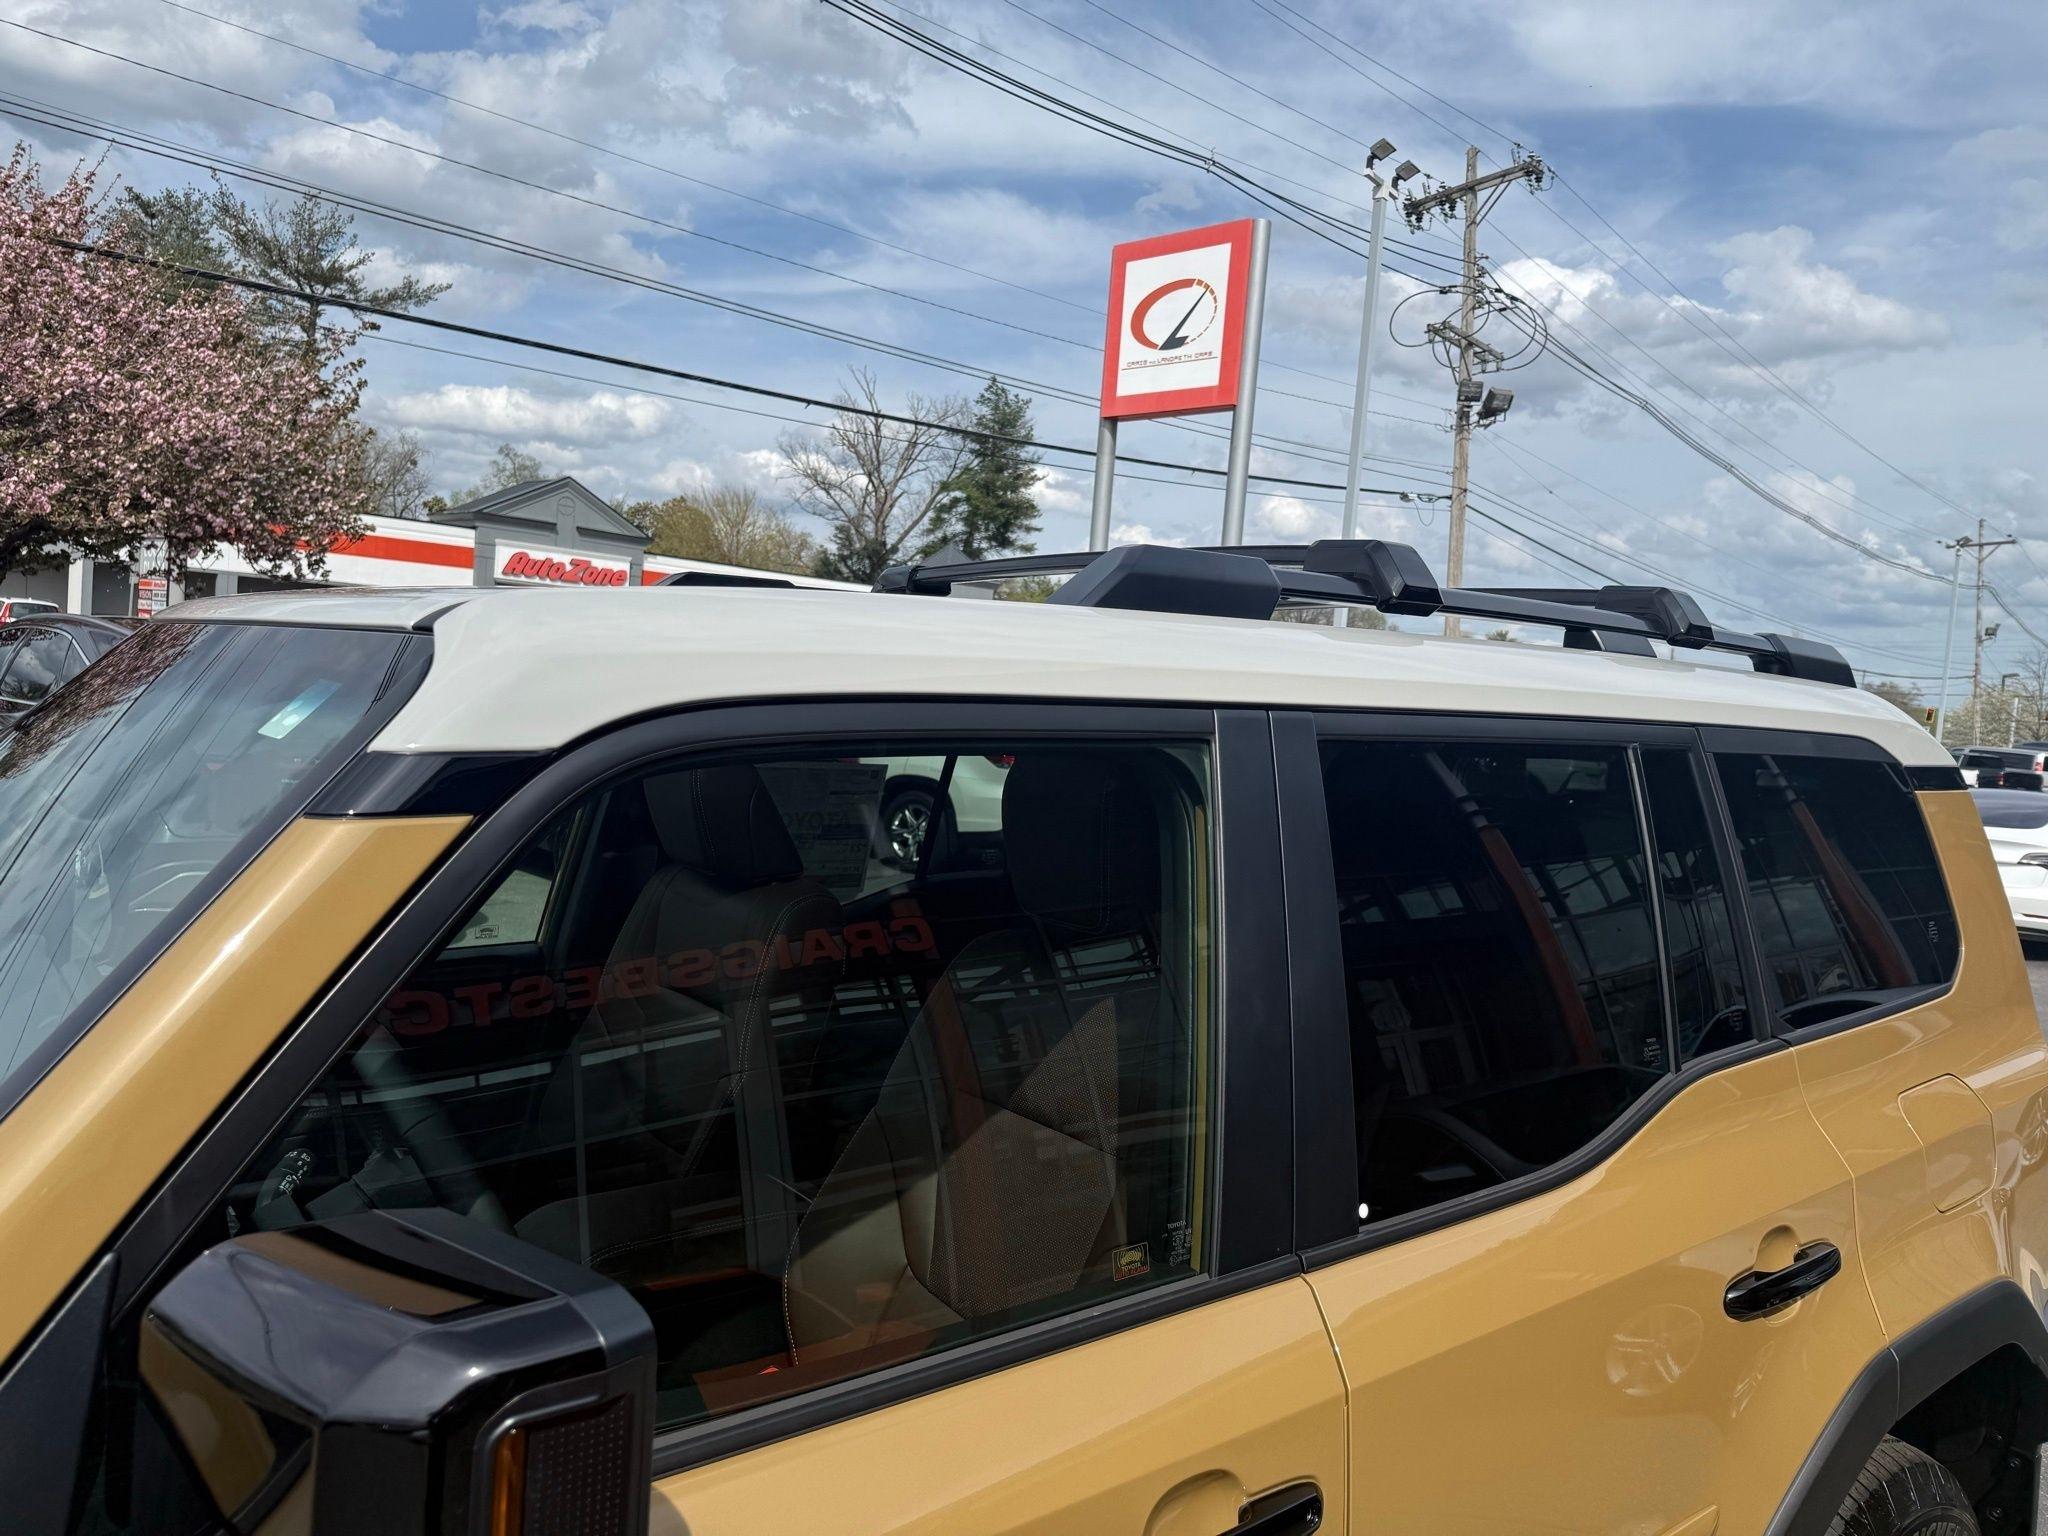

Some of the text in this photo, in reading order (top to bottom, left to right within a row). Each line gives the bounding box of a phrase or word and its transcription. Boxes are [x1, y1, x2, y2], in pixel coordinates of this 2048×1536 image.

[502, 551, 628, 587] AutoZone
[1167, 1220, 1186, 1229] TOYOTA
[1121, 1262, 1141, 1271] TOYOTA
